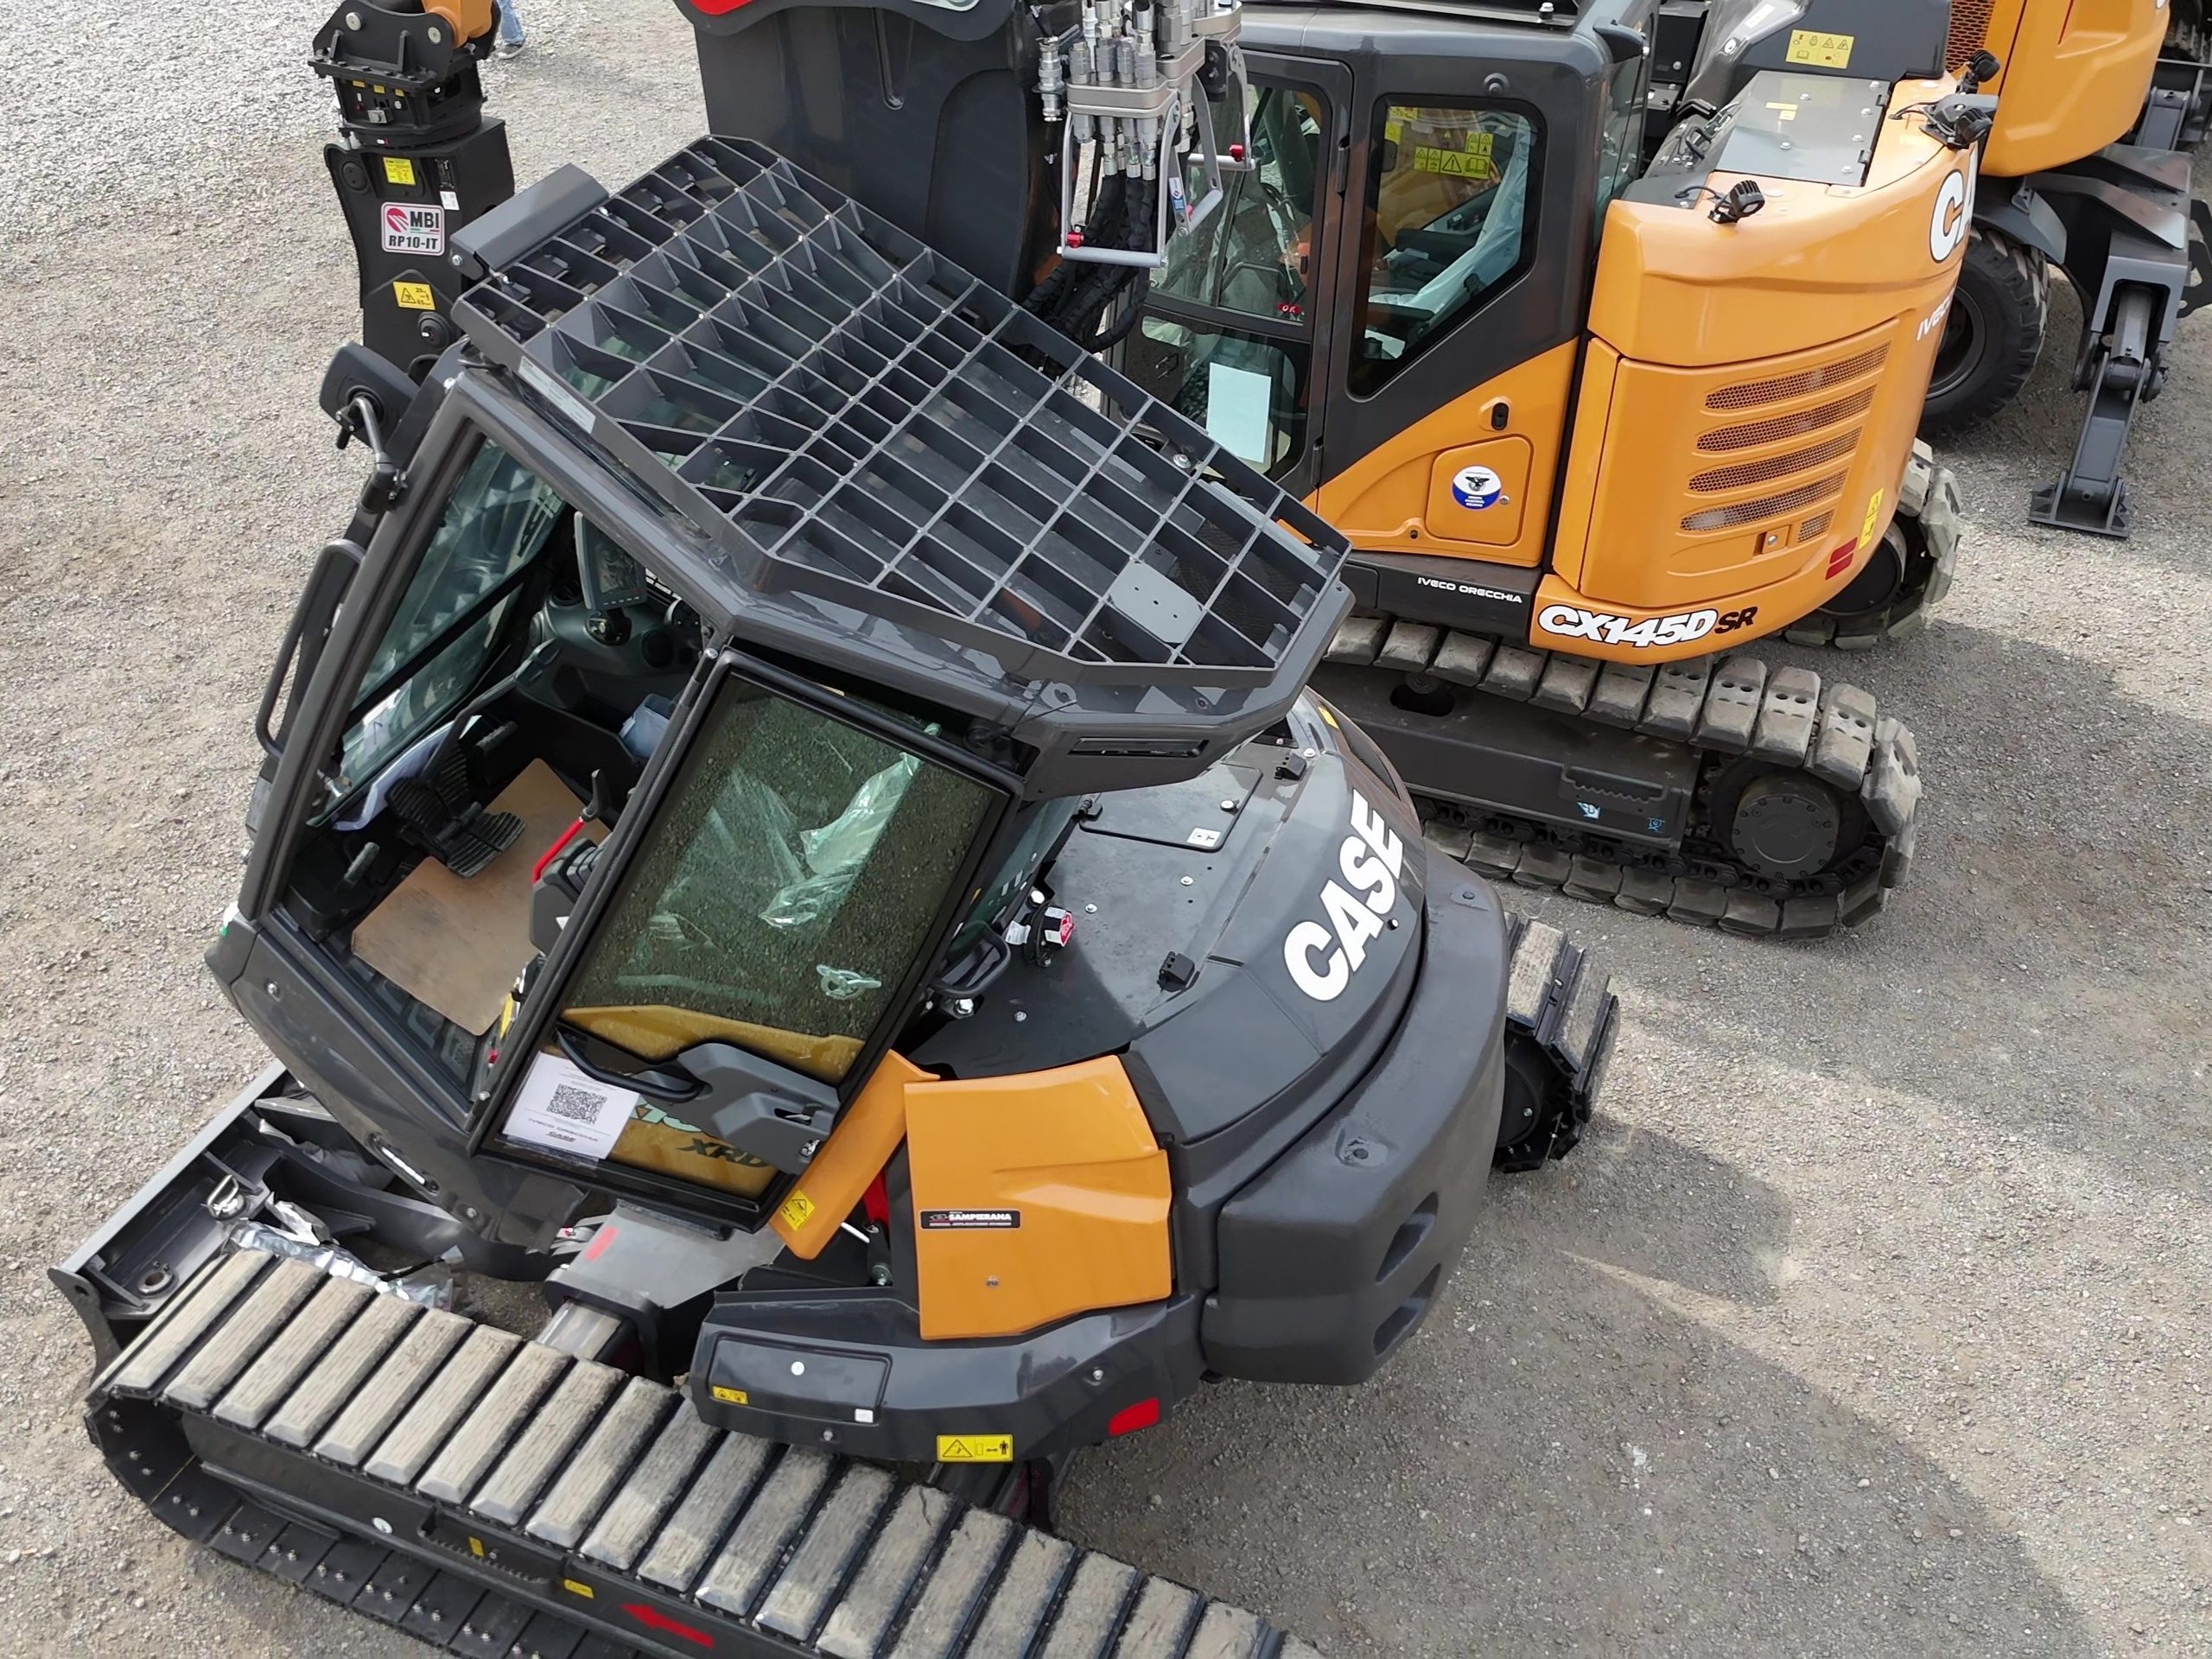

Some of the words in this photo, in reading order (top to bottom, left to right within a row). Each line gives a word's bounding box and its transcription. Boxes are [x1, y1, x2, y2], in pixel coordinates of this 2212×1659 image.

[410, 211, 440, 229] MBI
[389, 235, 439, 250] RP10-IT
[1417, 576, 1457, 591] IVECO
[1459, 585, 1522, 603] ORECCHIA
[1537, 604, 1718, 648] CX145D
[1714, 607, 1758, 634] SR
[1284, 788, 1403, 1001] CASE
